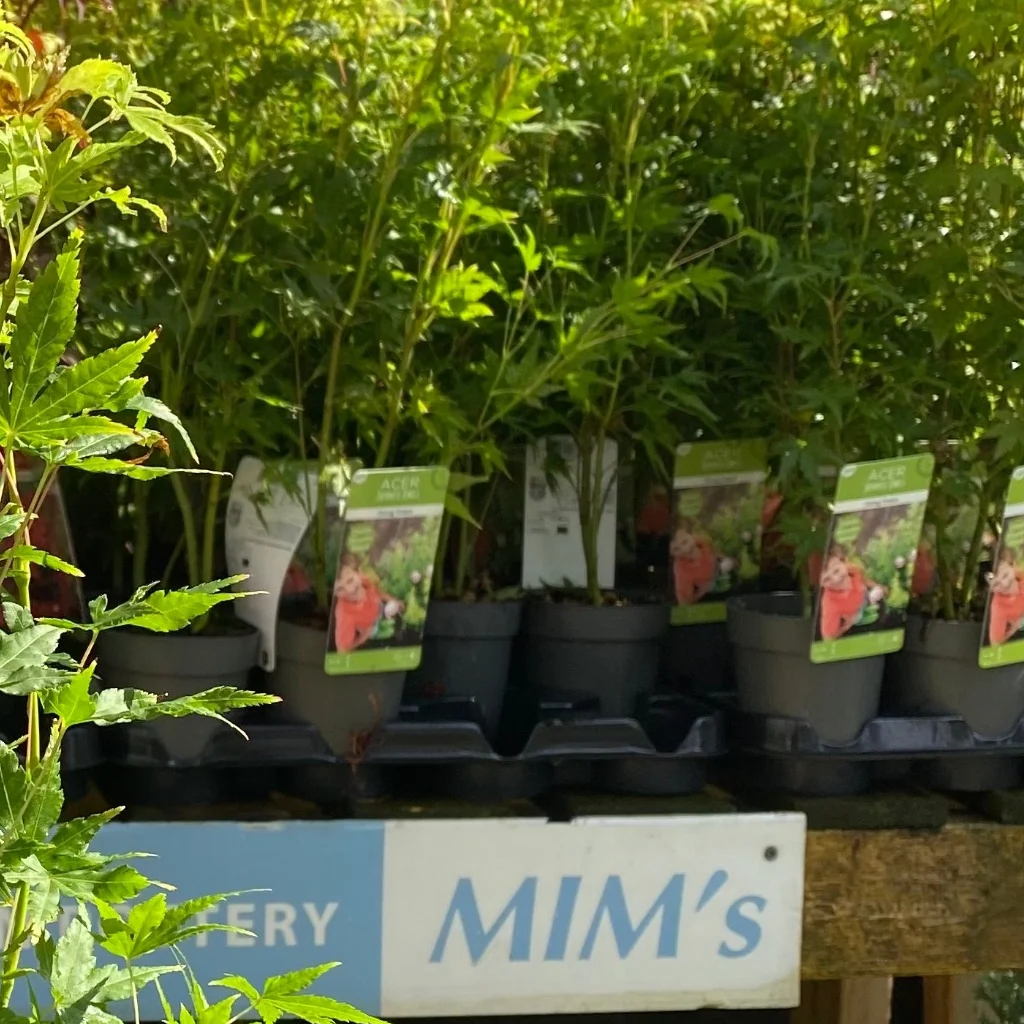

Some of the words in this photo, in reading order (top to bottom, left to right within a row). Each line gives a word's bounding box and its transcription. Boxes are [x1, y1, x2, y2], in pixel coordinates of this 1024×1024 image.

[868, 465, 908, 481] ACER
[379, 475, 421, 490] ACER
[429, 869, 769, 967] MIM's
